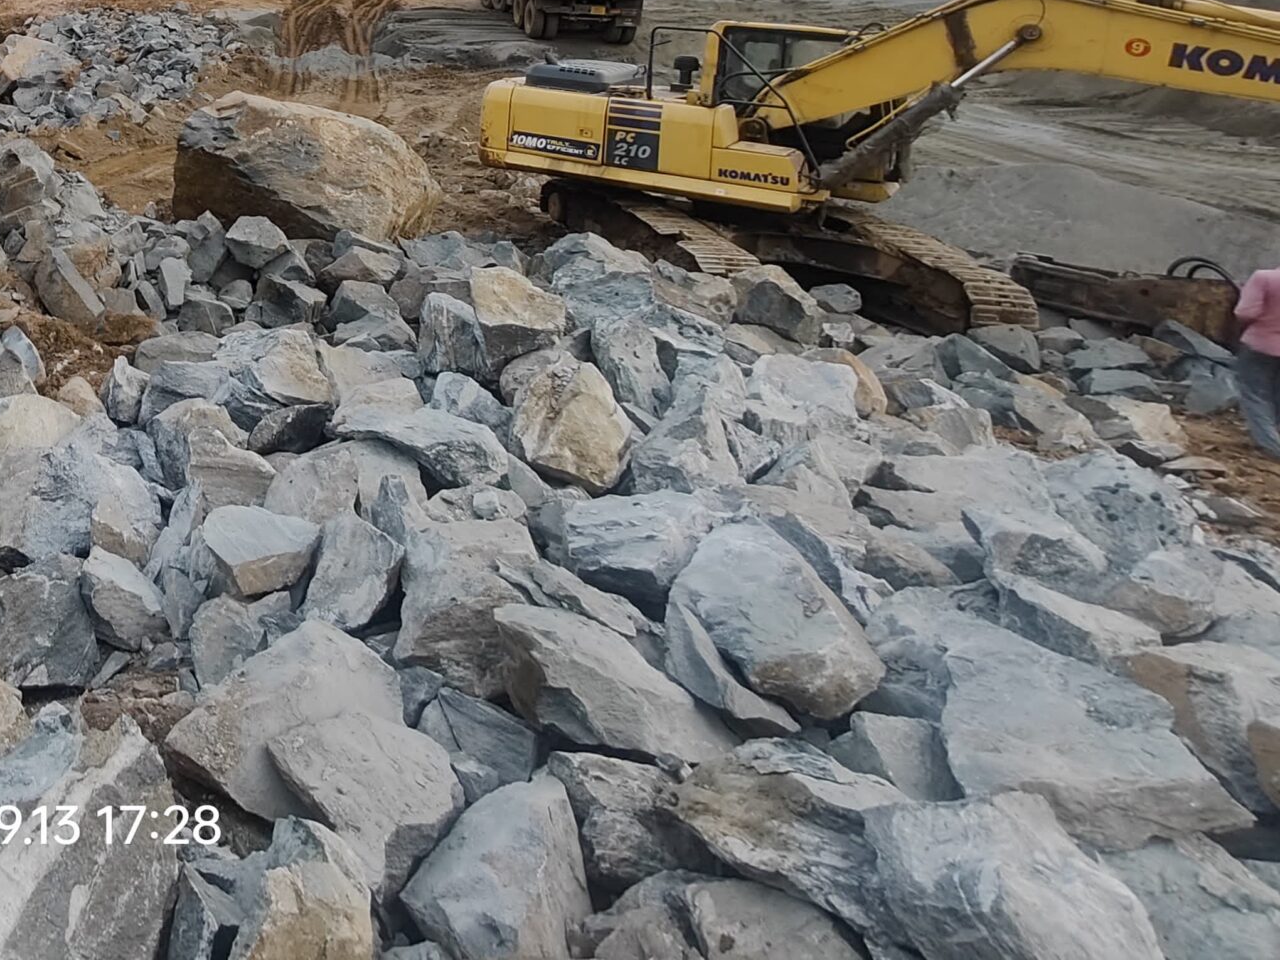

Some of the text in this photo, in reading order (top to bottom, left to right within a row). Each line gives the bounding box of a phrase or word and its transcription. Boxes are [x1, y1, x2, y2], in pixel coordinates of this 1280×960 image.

[615, 131, 635, 143] PC
[546, 144, 584, 155] EFFICIENT
[613, 142, 651, 159] 210
[613, 156, 629, 166] LC
[718, 168, 790, 186] KOMATSU
